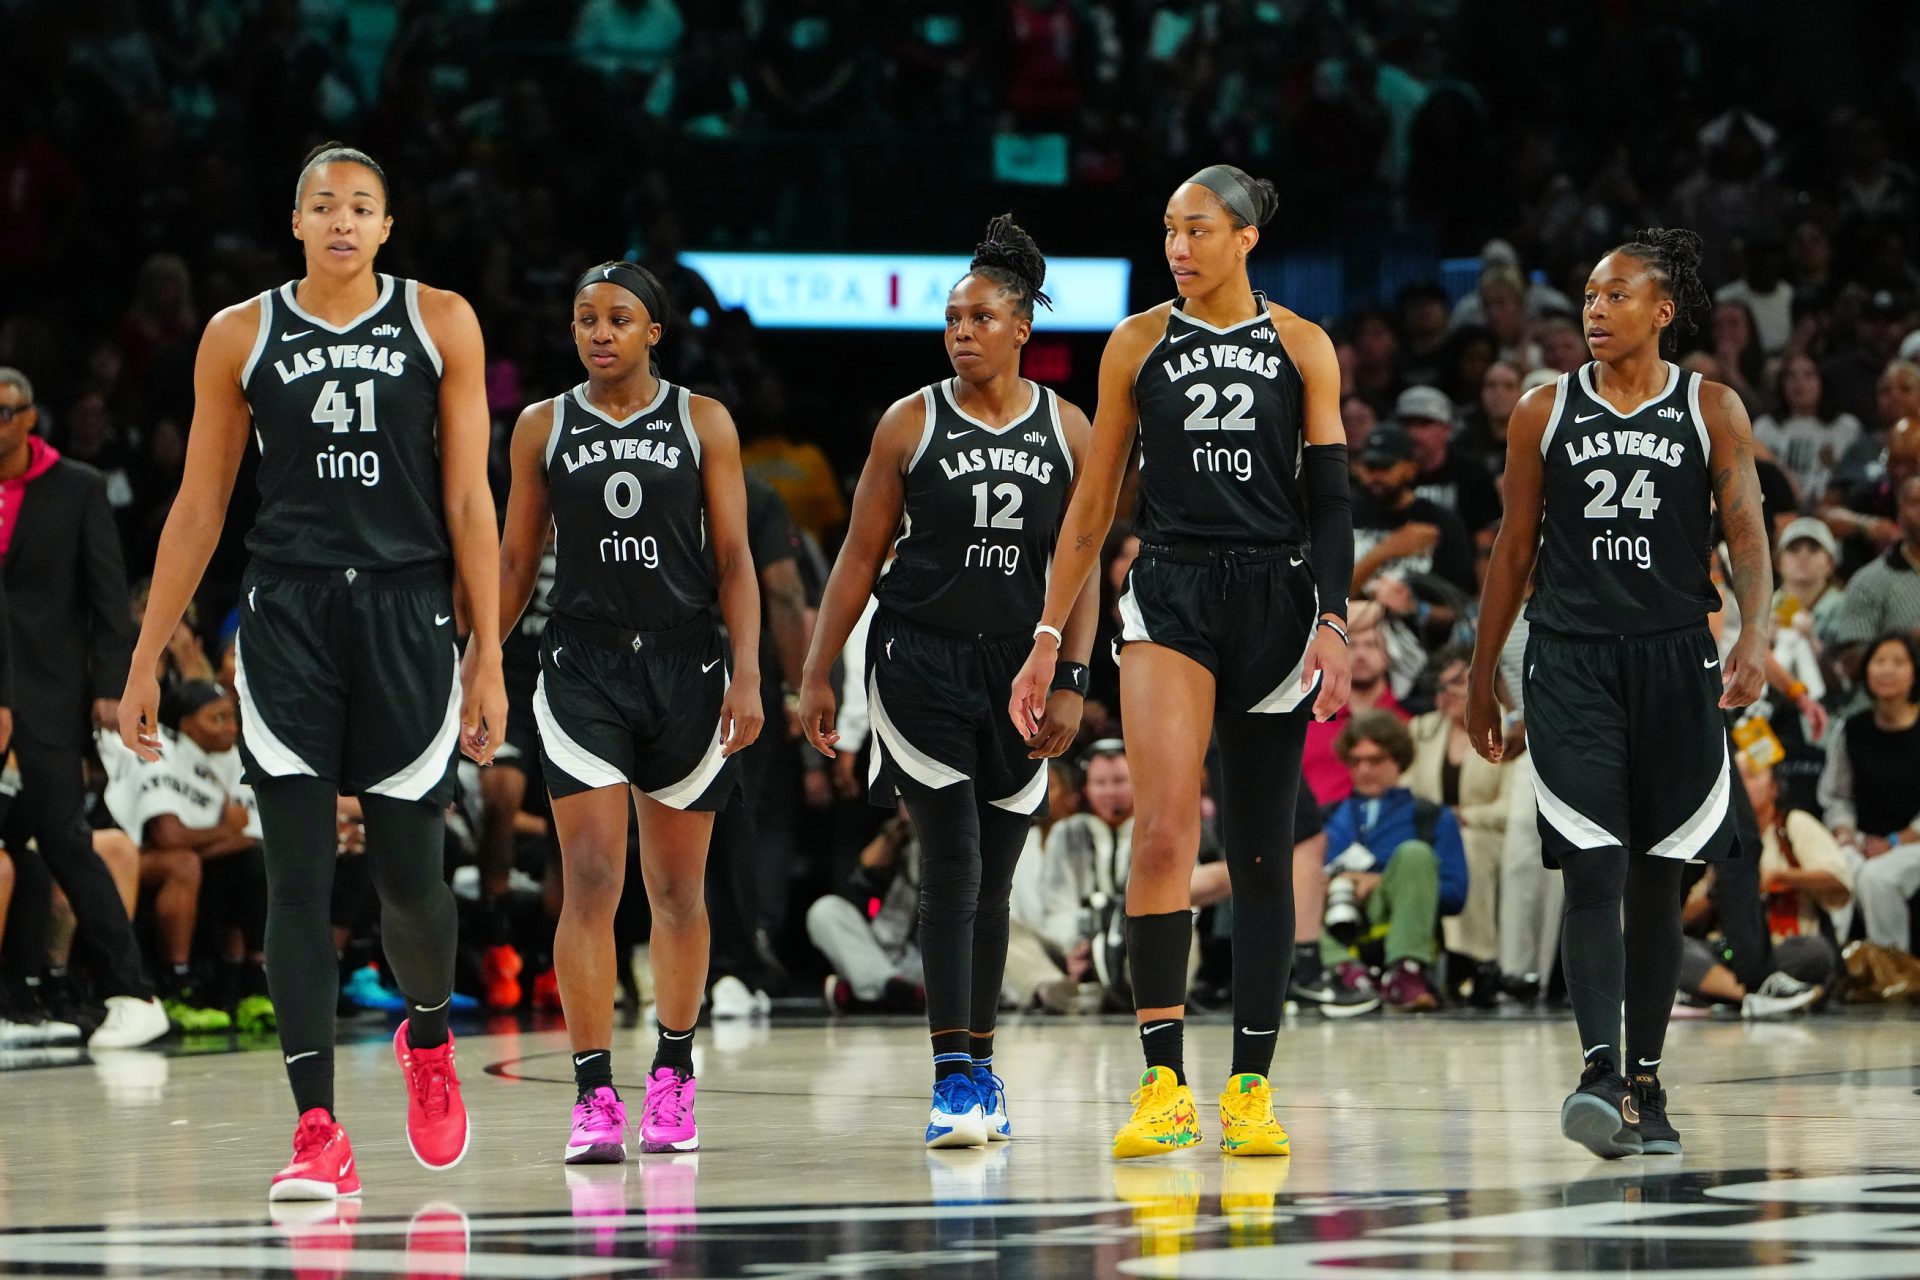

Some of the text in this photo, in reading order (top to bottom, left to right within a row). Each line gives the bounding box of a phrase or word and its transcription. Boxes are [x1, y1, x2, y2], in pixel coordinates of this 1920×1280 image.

[371, 324, 401, 338] ally
[1251, 327, 1276, 343] ally
[273, 344, 407, 384] LAS VEGAS
[1162, 344, 1281, 383] LAS VEGAS
[311, 378, 377, 433] 41
[1184, 382, 1255, 431] 22
[1657, 407, 1684, 422] ally
[646, 419, 672, 432] ally
[1023, 431, 1047, 446] ally
[316, 444, 380, 487] ring
[561, 438, 681, 474] LAS VEGAS
[938, 447, 1054, 485] LAS VEGAS
[1193, 441, 1251, 482] ring
[1564, 430, 1685, 467] LAS VEGAS
[604, 471, 643, 519] 0
[972, 481, 1024, 530] 12
[1584, 469, 1661, 520] 24
[600, 530, 659, 569] ring
[965, 537, 1020, 576] ring
[1592, 529, 1651, 569] ring
